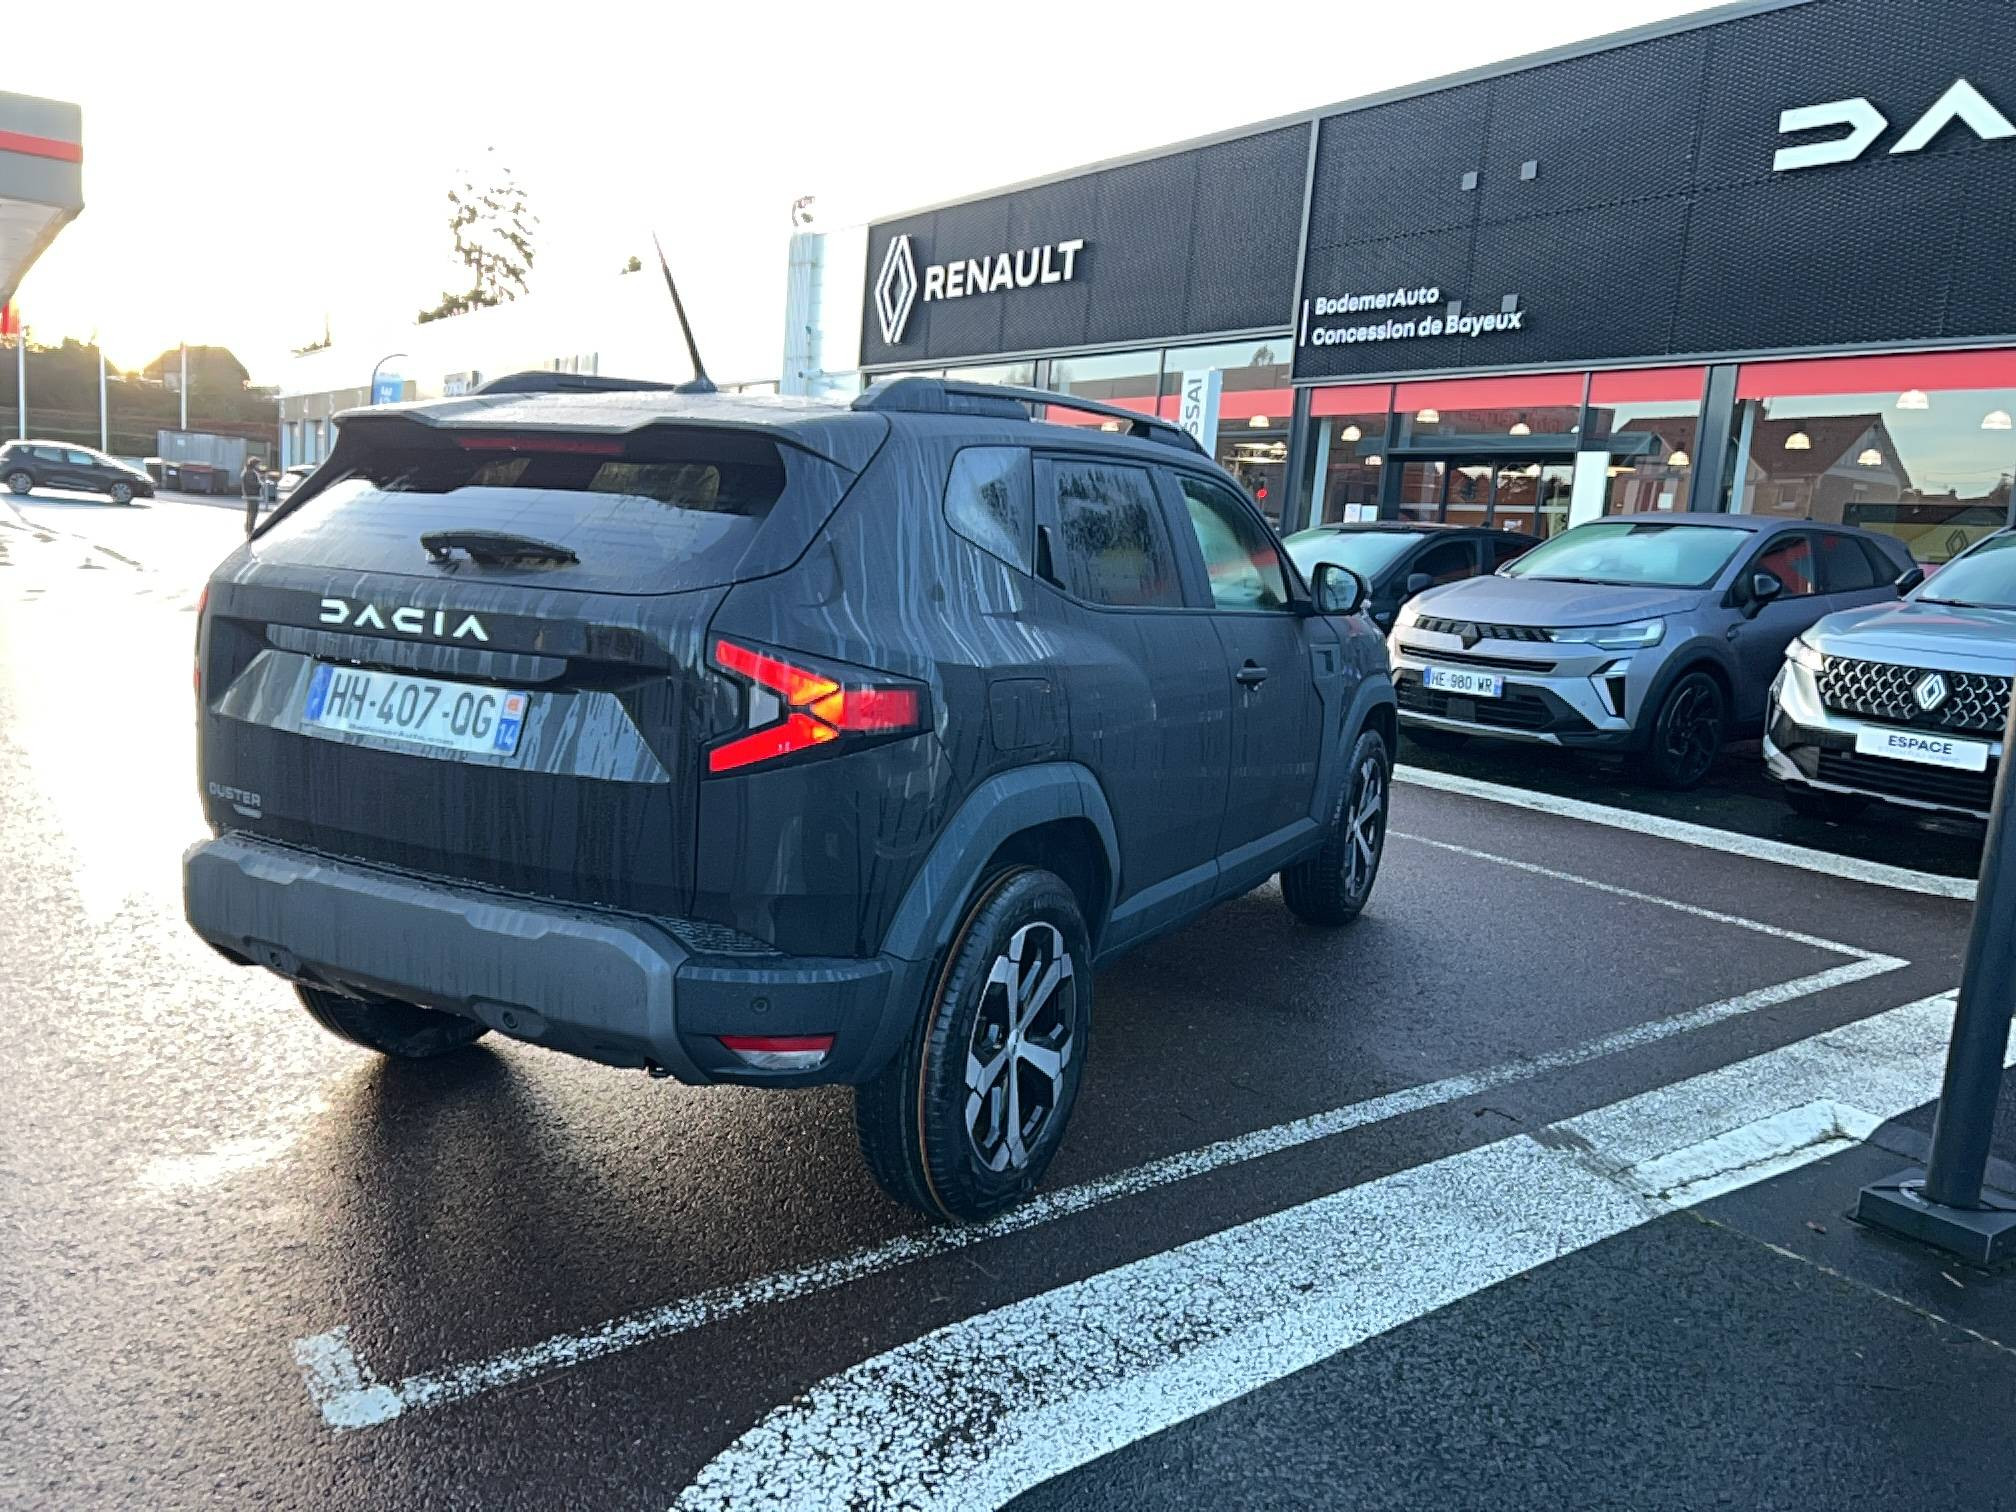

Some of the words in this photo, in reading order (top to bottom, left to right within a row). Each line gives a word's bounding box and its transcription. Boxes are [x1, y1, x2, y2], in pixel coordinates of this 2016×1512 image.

[923, 239, 1084, 302] RENAULT
[1314, 286, 1440, 316] BodemerAuto
[1311, 319, 1416, 346] Concession
[1417, 315, 1443, 337] de
[1444, 311, 1523, 338] Bayeux
[1183, 378, 1202, 438] SSAI
[320, 598, 489, 642] DACIA
[497, 722, 515, 746] 14
[1887, 734, 1954, 755] ESPACE
[208, 781, 262, 808] DUSTER
